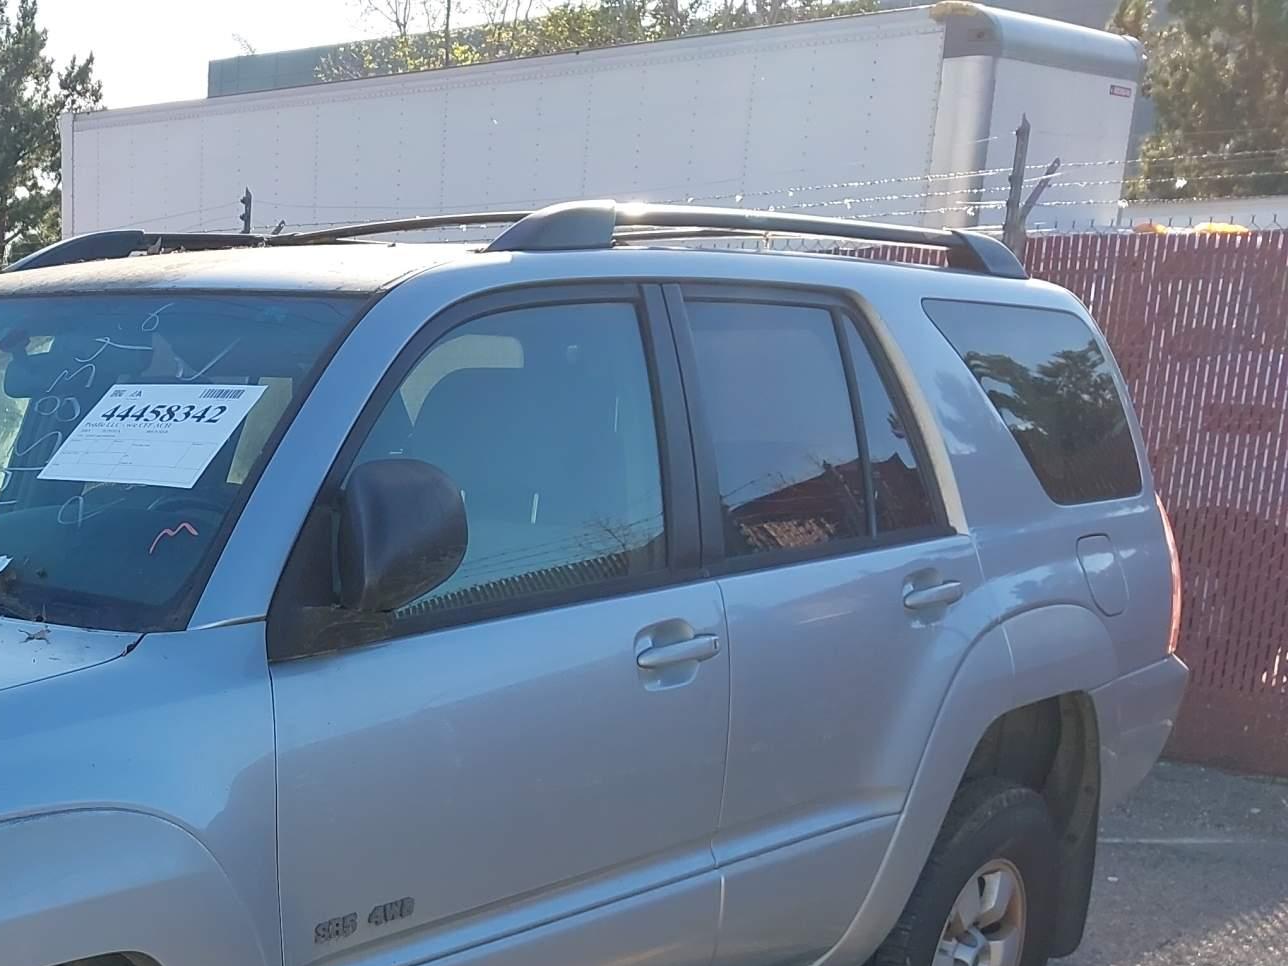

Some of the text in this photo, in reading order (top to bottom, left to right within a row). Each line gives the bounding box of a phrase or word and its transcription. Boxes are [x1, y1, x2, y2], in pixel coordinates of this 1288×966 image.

[101, 404, 227, 424] 44458342
[314, 896, 416, 944] SR5 4WD
